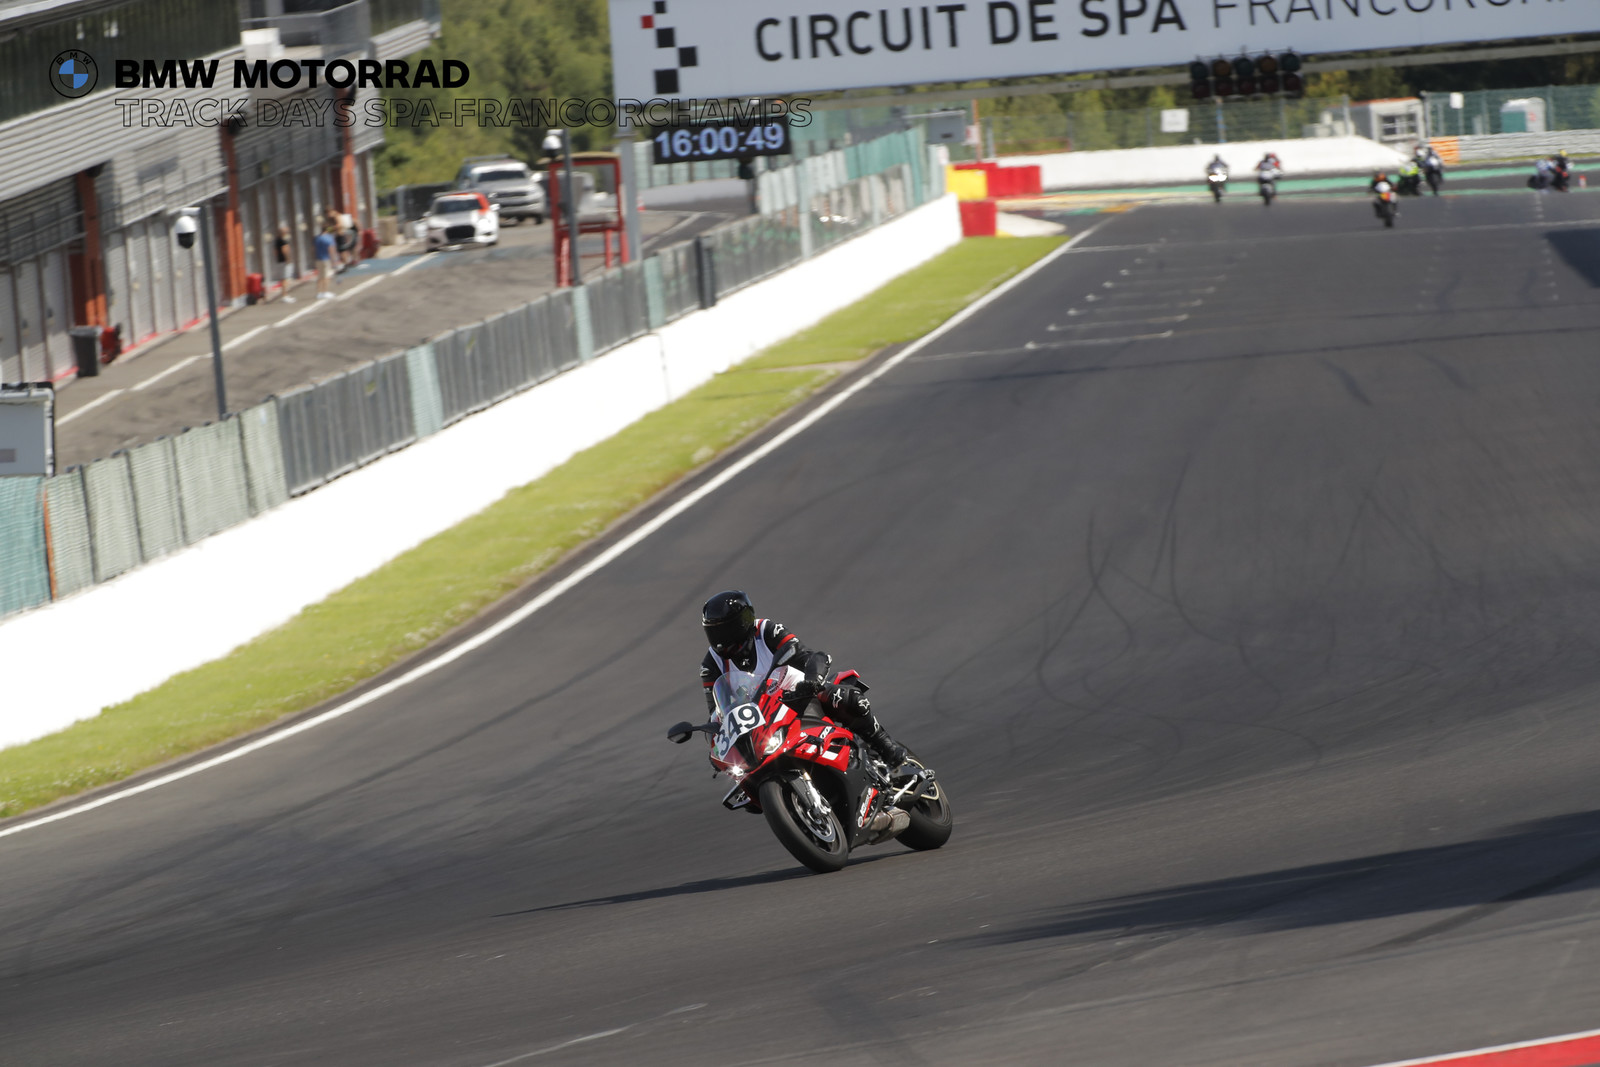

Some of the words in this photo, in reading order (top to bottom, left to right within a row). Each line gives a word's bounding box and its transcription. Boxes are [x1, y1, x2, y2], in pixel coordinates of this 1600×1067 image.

[755, 4, 966, 62] CIRCUIT
[988, 0, 1059, 45] DE
[1080, 0, 1188, 37] SPA
[655, 122, 785, 158] 16:00:49
[716, 705, 760, 756] 349
